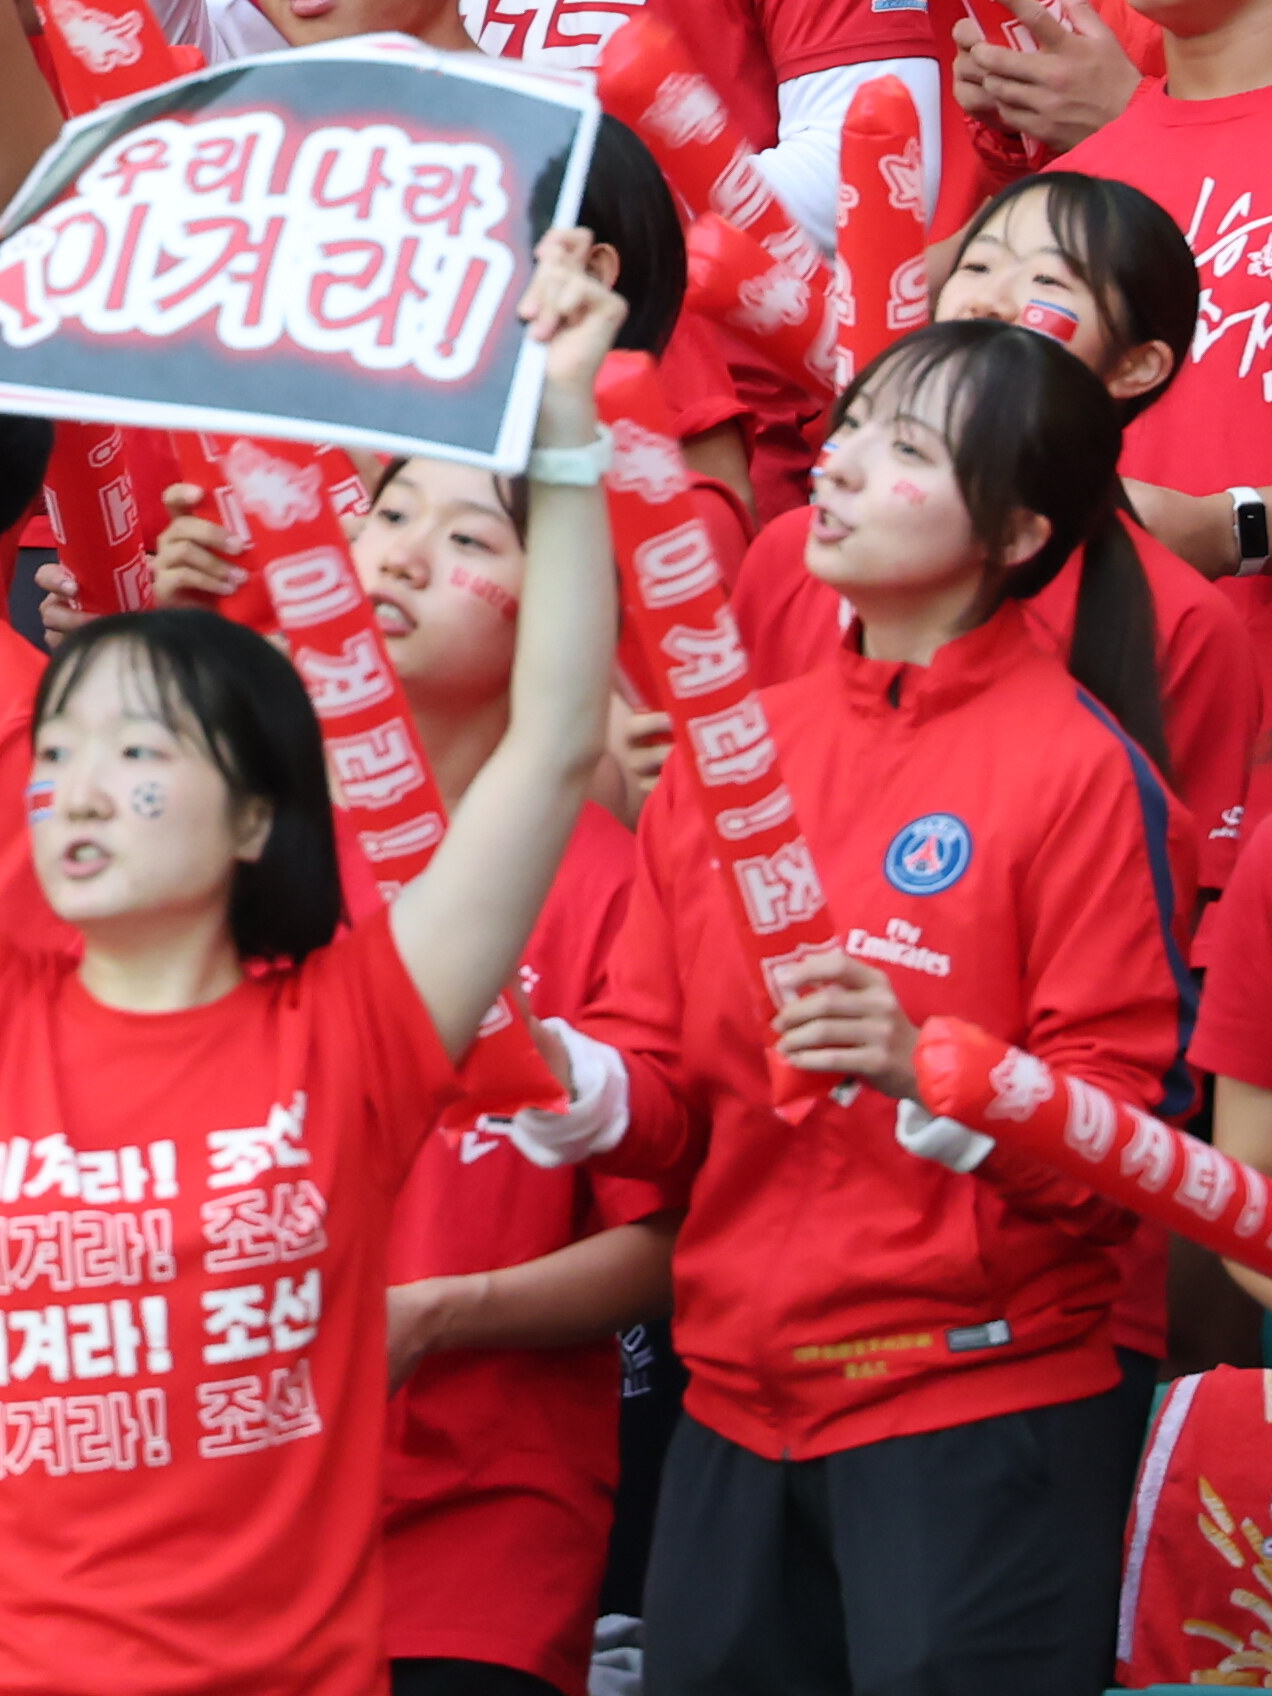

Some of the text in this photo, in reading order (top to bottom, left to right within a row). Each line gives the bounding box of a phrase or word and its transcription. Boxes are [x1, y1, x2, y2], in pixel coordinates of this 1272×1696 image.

[43, 201, 492, 359] 이겨라!
[264, 551, 445, 863] 이겨라!
[634, 521, 796, 842] 이겨라!
[205, 1089, 312, 1190] 조선
[199, 1179, 329, 1275] 조선
[200, 1268, 323, 1366] 조선
[195, 1358, 325, 1460] 조선
